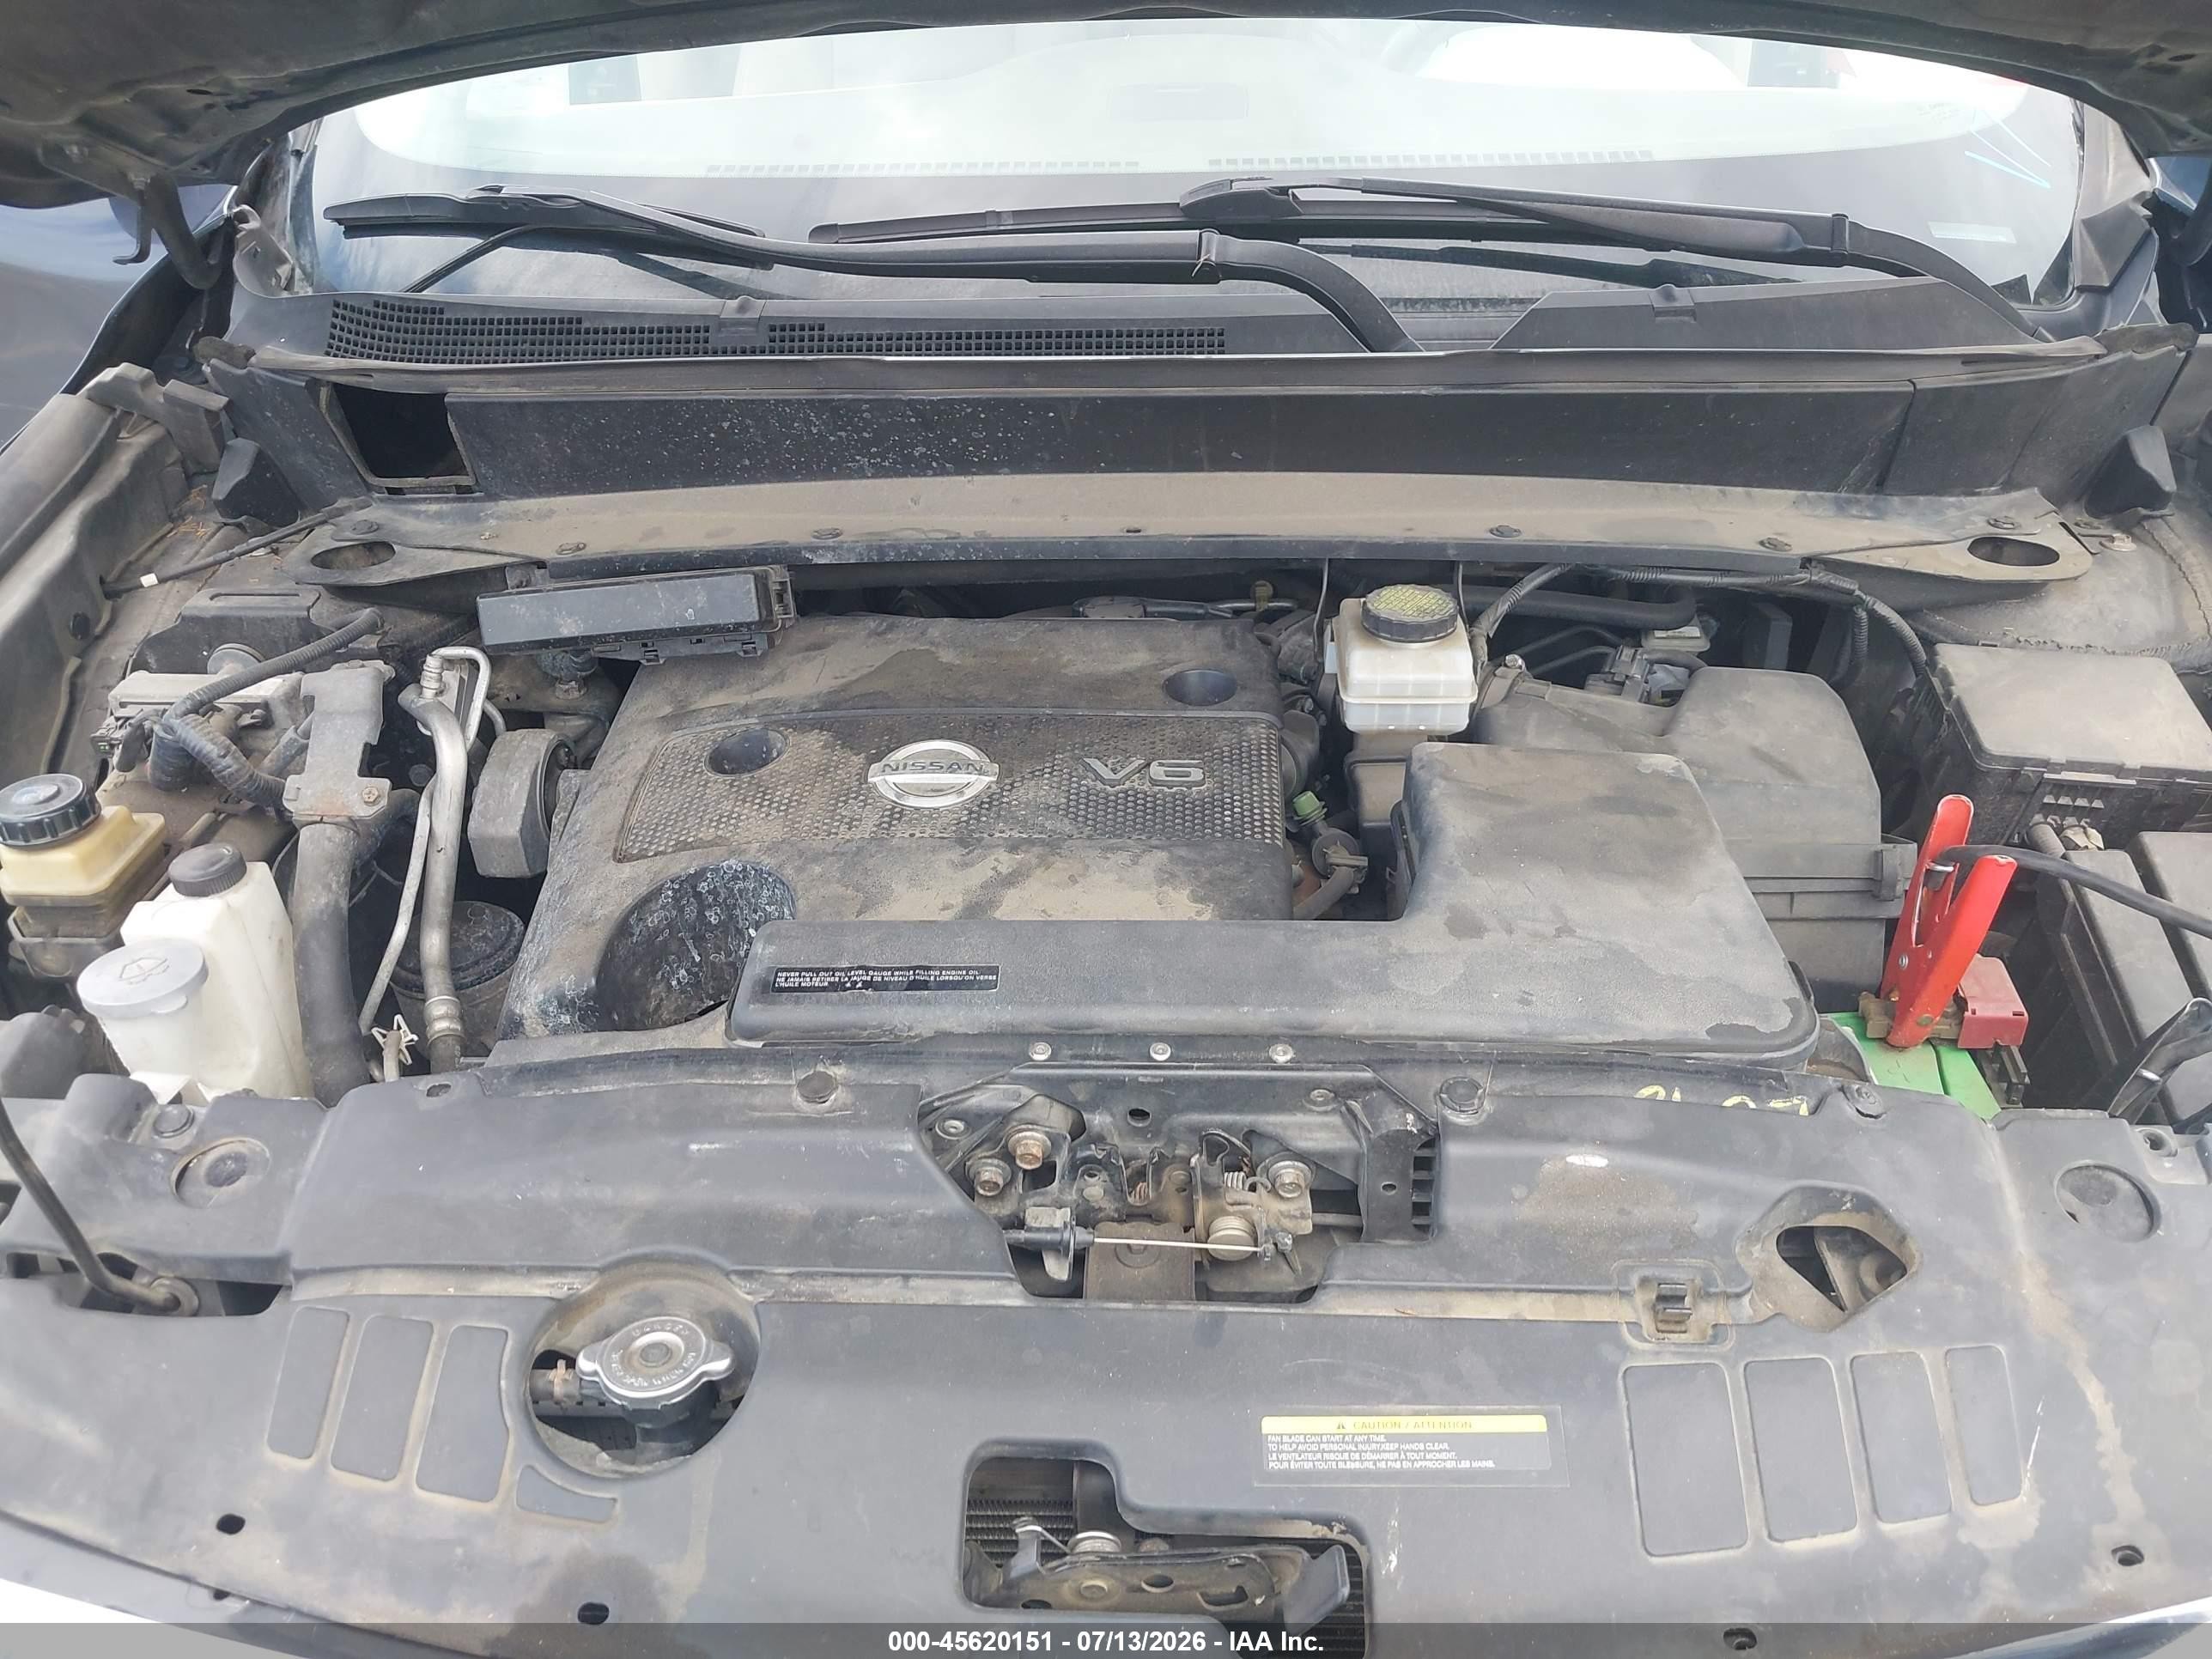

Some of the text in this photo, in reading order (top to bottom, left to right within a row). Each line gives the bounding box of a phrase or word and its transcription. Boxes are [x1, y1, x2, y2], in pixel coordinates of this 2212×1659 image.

[882, 760, 985, 774] NISSAN
[1079, 757, 1205, 788] V6
[1344, 1434, 1352, 1443] AT
[1353, 1434, 1368, 1443] ANY
[1323, 1452, 1349, 1461] RISQUE
